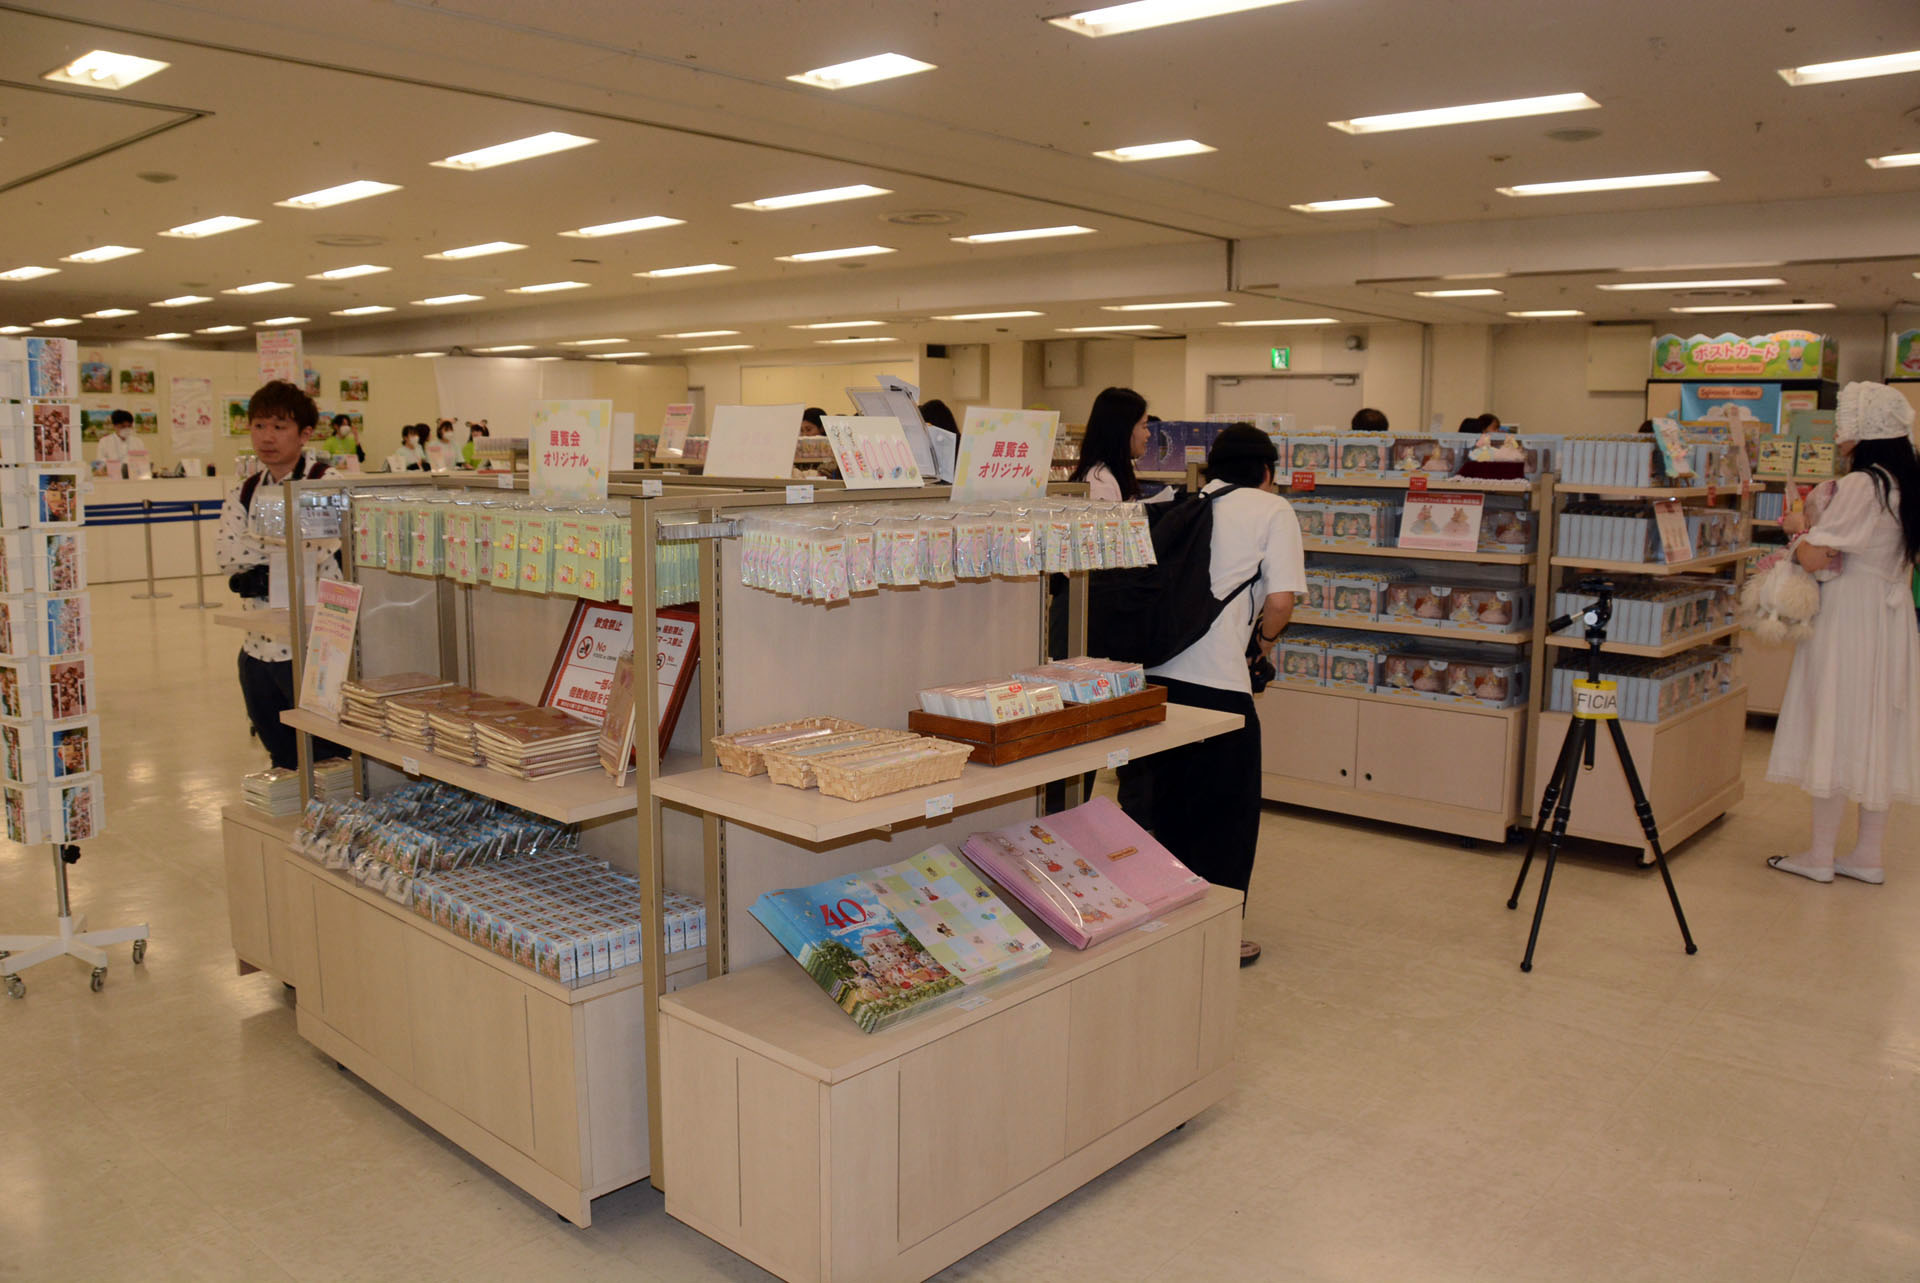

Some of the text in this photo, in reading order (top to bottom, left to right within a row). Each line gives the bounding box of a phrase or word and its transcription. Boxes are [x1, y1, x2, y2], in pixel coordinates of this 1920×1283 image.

[1693, 343, 1779, 362] ポストカード
[549, 430, 581, 447] 展覧会
[992, 441, 1029, 458] 展覧会
[543, 451, 590, 468] オリジナル
[978, 462, 1034, 479] オリジナル
[594, 616, 624, 632] 飲食禁止
[596, 641, 607, 652] No
[656, 635, 683, 648] マース禁止
[1576, 692, 1617, 710] FICIA
